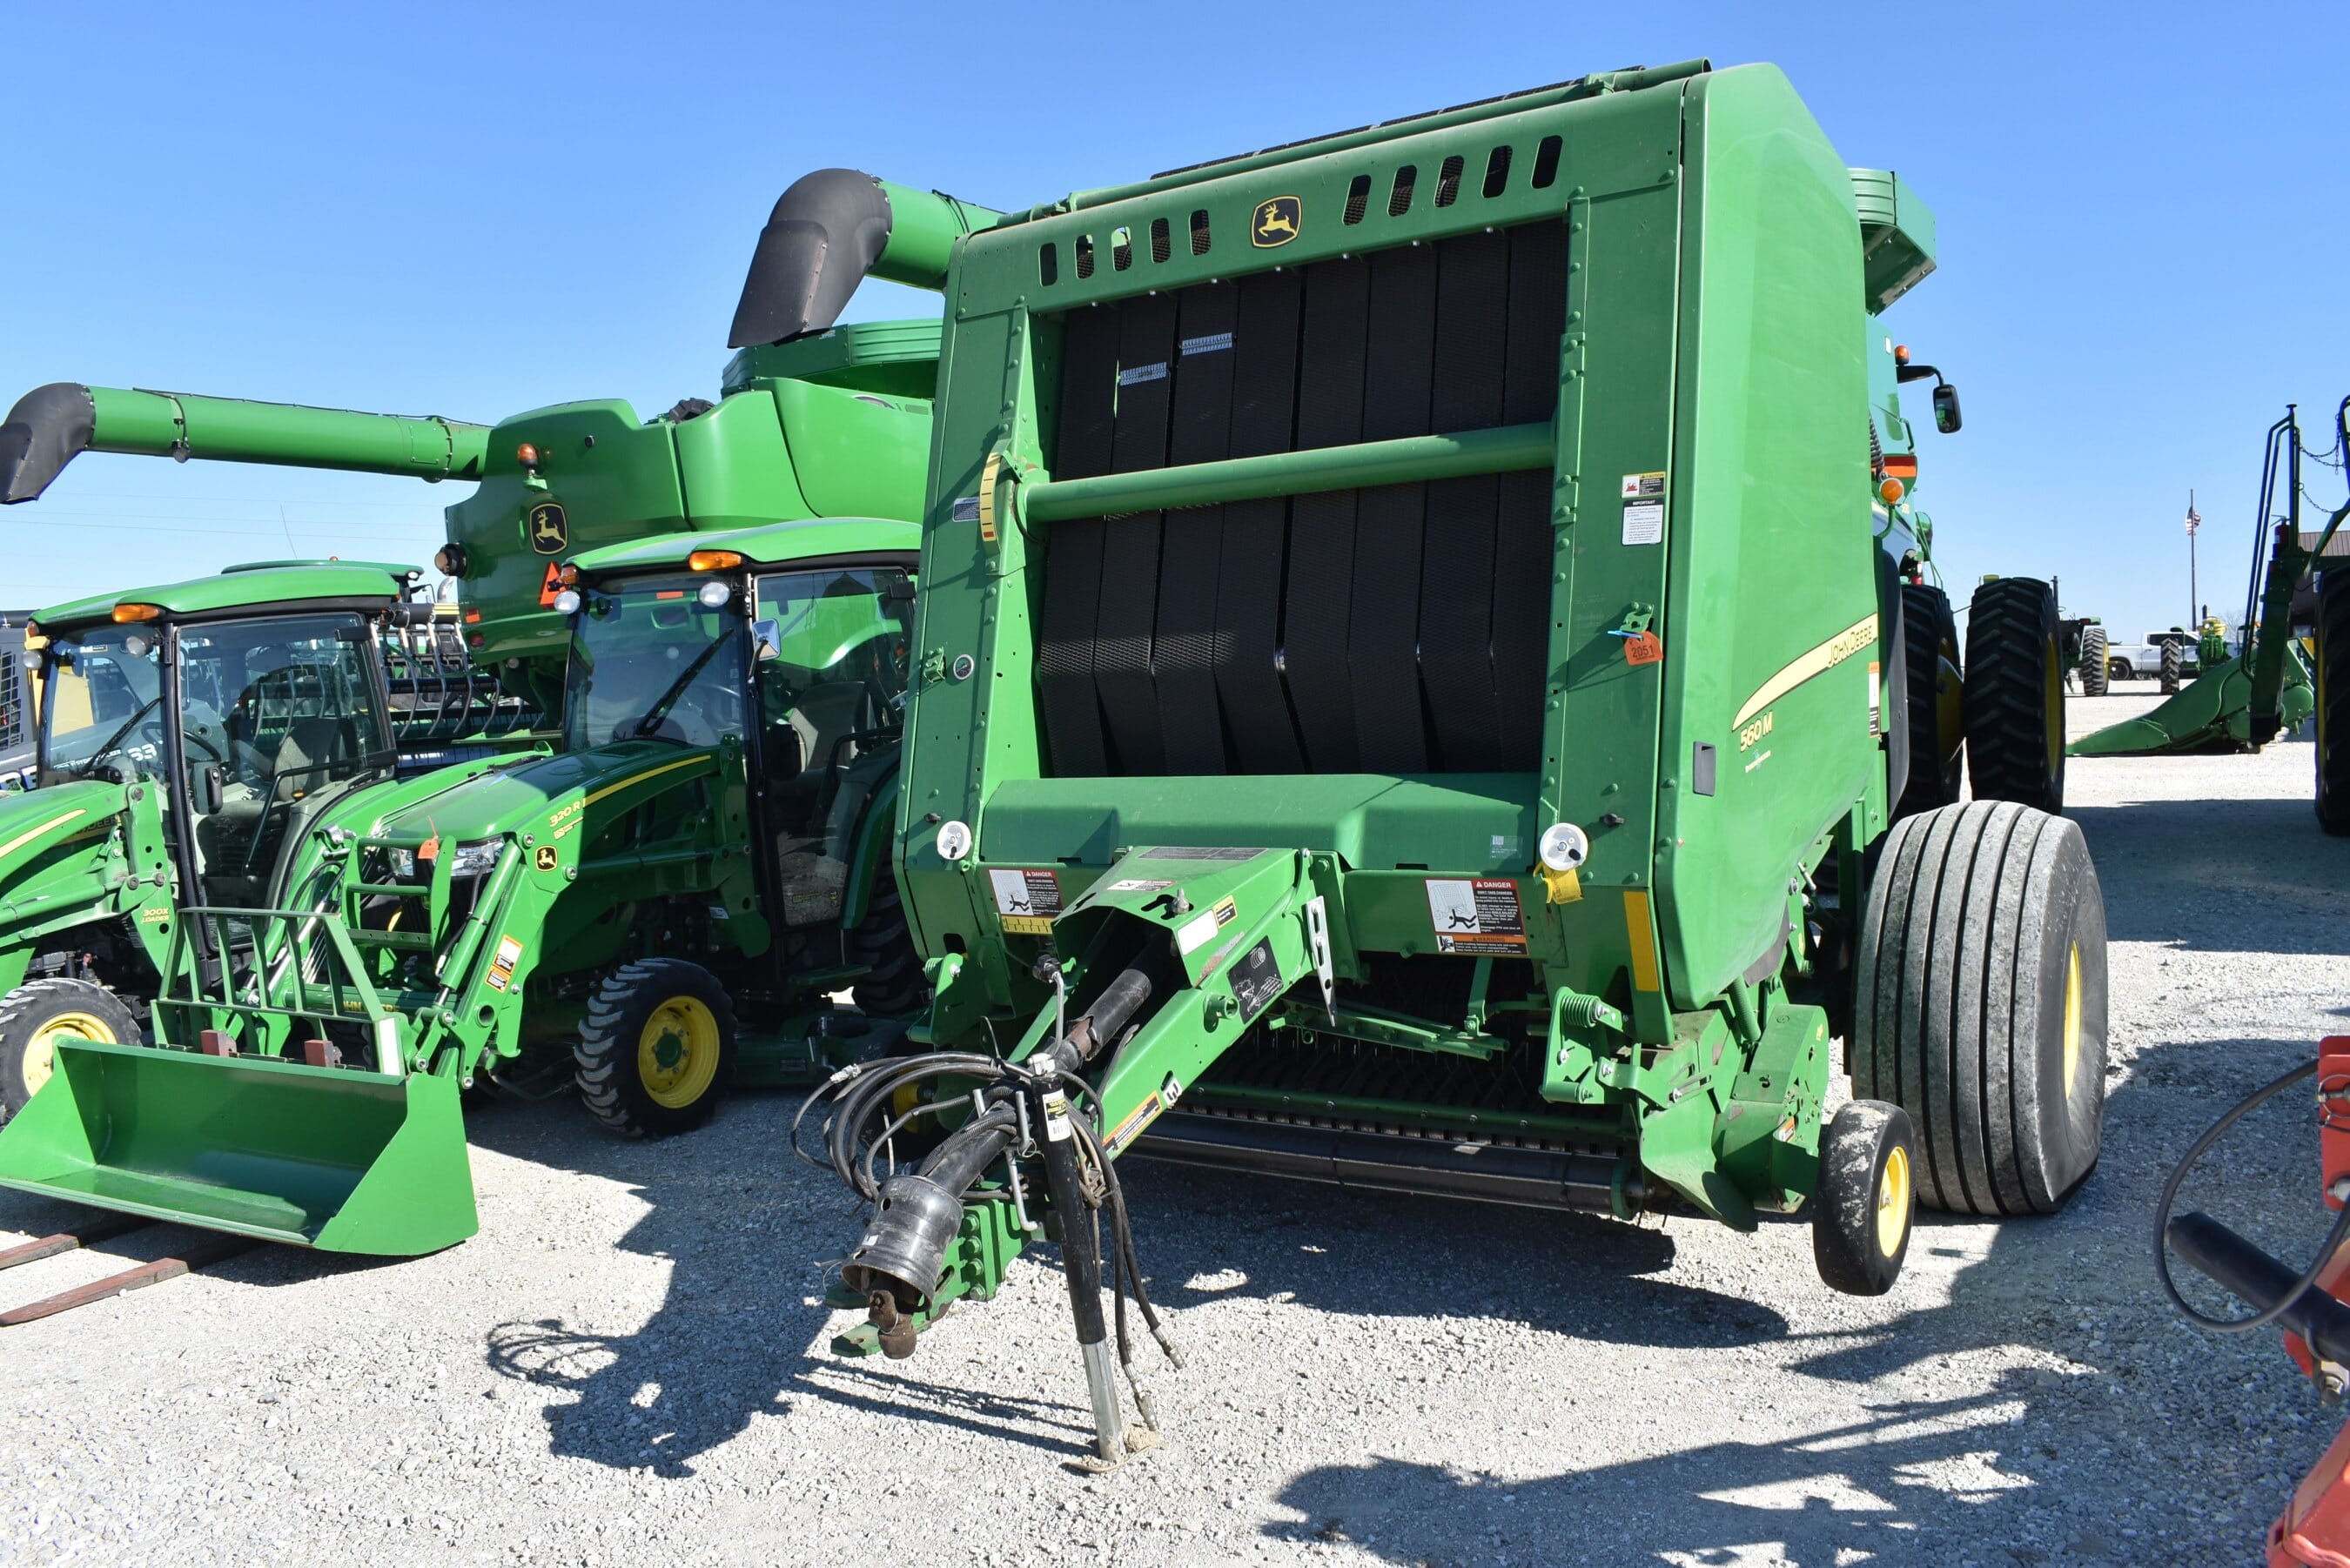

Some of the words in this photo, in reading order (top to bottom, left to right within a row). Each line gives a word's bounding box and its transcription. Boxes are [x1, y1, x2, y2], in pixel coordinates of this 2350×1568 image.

[1631, 644, 1655, 658] 2051
[1828, 637, 1850, 665] JOHN
[1850, 625, 1872, 651] DEERE
[143, 907, 170, 917] 300X
[141, 915, 170, 923] LOADER
